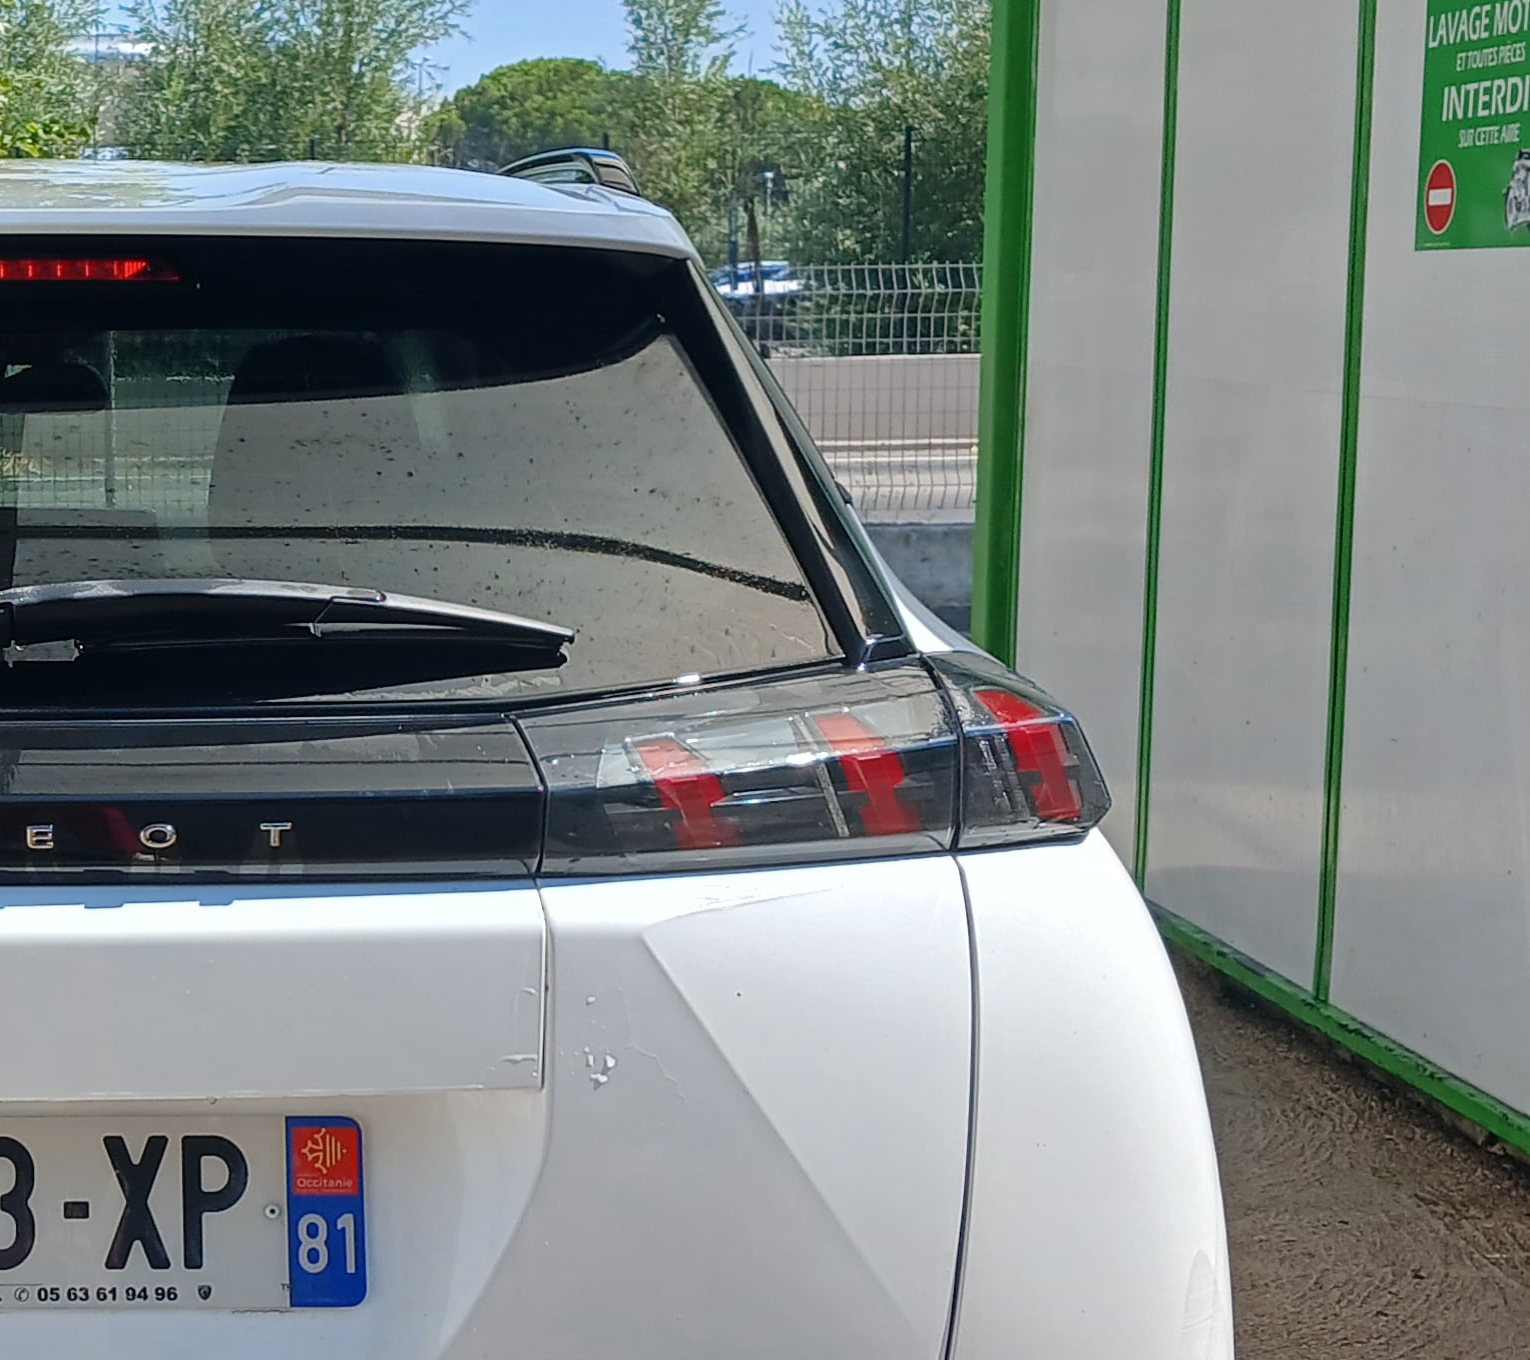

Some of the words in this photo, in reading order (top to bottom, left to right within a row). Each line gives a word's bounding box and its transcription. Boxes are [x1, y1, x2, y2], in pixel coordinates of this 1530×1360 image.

[1428, 4, 1492, 49] LAVAGE
[1456, 51, 1467, 71] ET
[1468, 46, 1498, 70] TOUTES
[1458, 128, 1475, 147] SUR
[1475, 125, 1500, 147] CETTE
[297, 1177, 353, 1188] Occitanie
[298, 1213, 356, 1274] 81
[37, 1287, 61, 1302] 05
[66, 1287, 90, 1302] 63
[96, 1287, 117, 1302] 61
[125, 1286, 149, 1301] 94
[154, 1286, 178, 1301] 96
